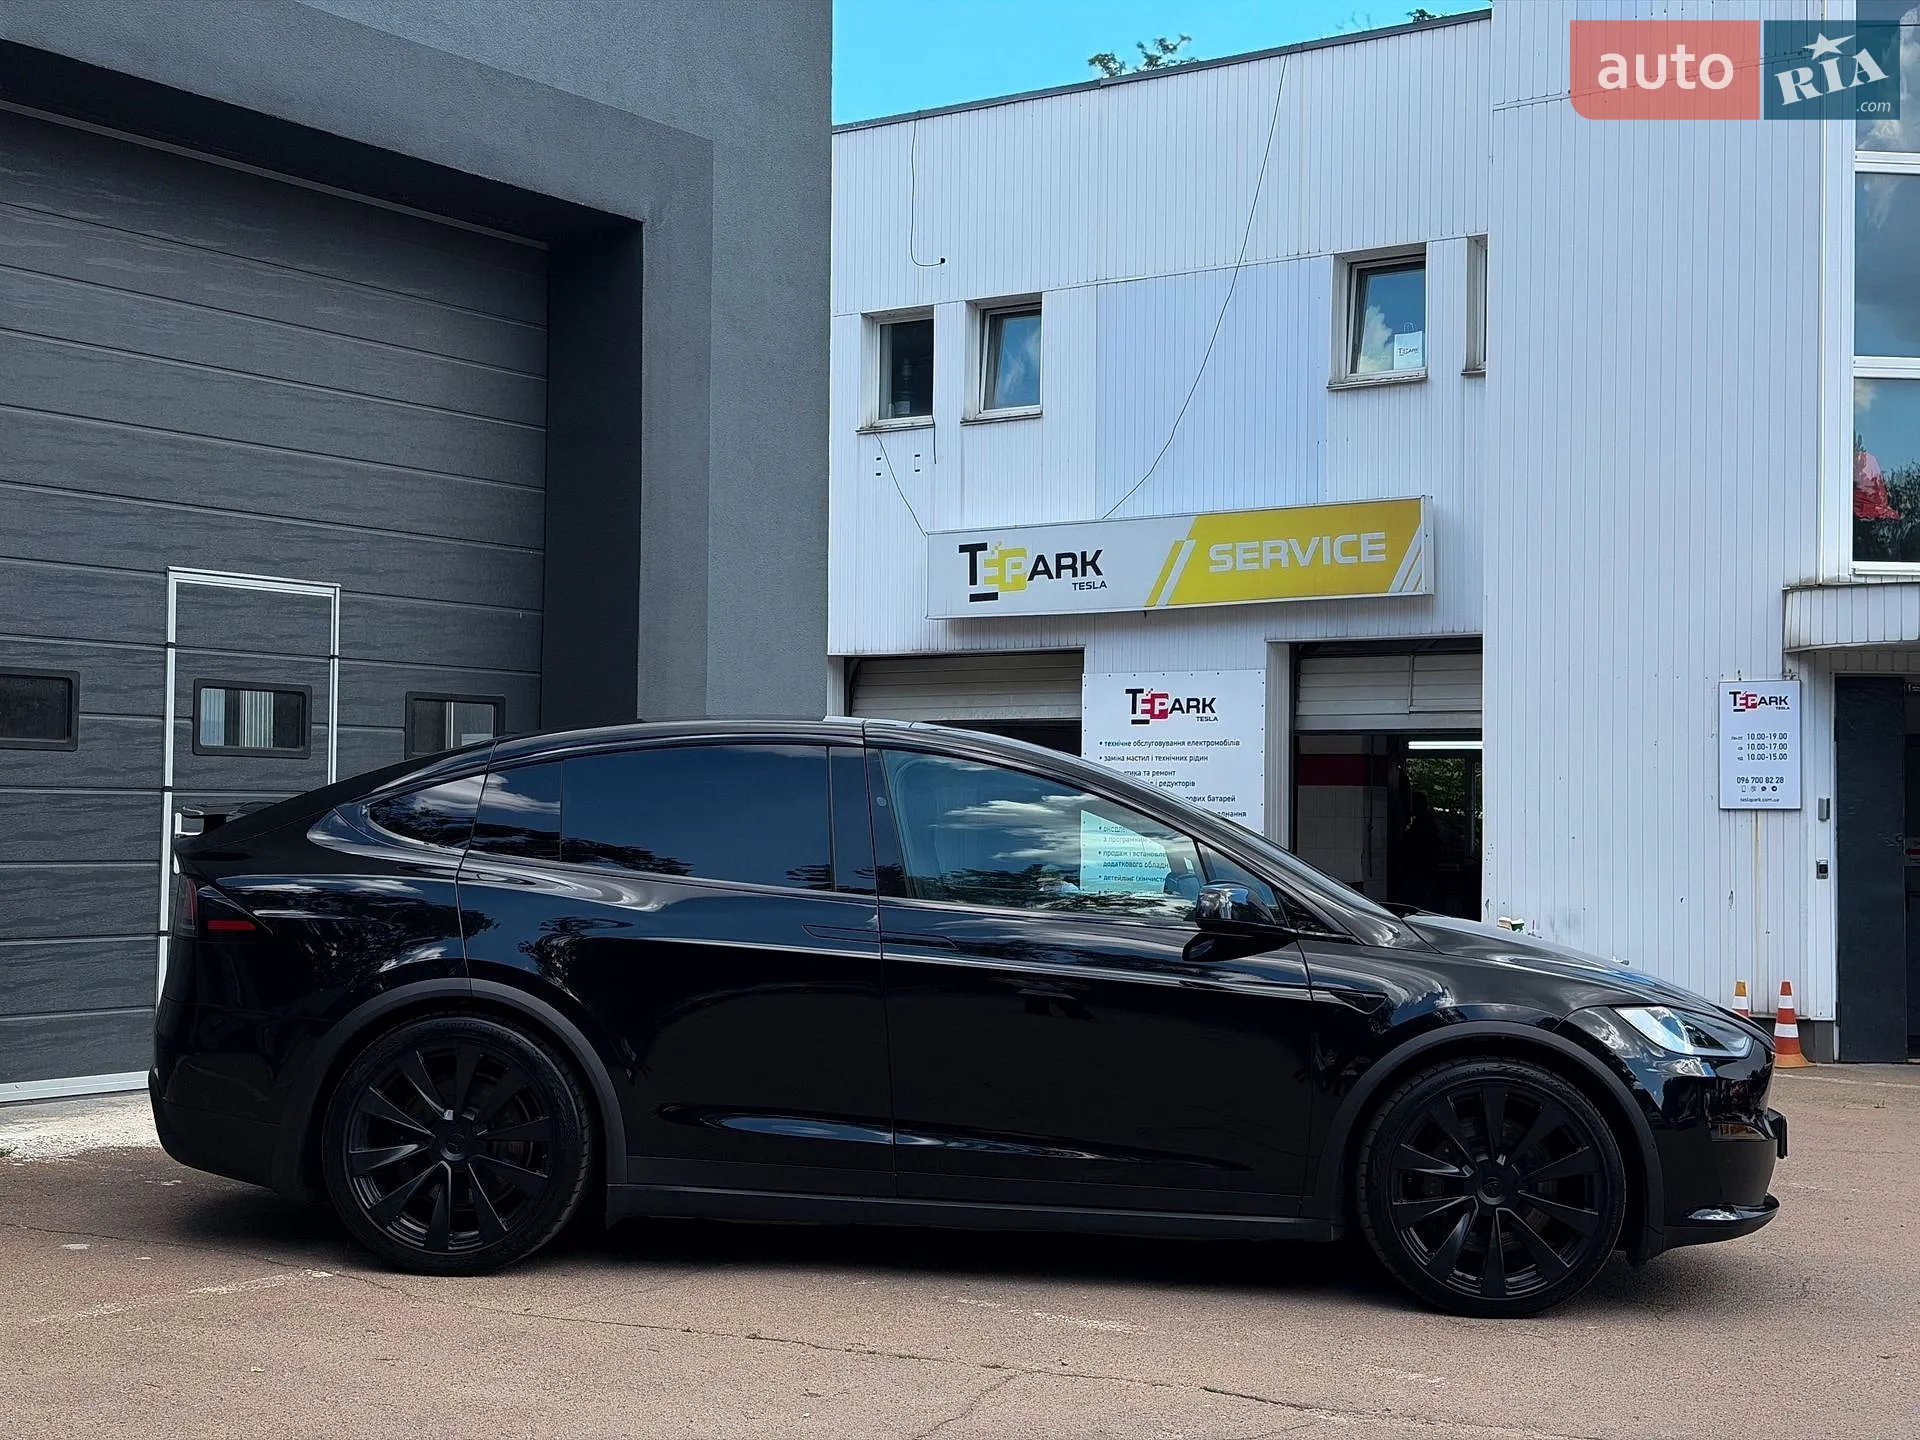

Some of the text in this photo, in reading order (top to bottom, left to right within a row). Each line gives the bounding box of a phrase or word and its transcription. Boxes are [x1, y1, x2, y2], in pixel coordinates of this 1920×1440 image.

[1208, 531, 1387, 574] SERVICE
[1071, 580, 1108, 591] TESLA
[1747, 732, 1788, 740] 10.00-19.00
[1132, 739, 1186, 748] обслуговування
[1187, 739, 1241, 748] електромобілів
[1747, 742, 1788, 750] 10.00-17.00
[1189, 754, 1209, 763] рідин
[1747, 752, 1788, 760] 10.00-15.00
[1151, 770, 1176, 778] ремонт
[1158, 780, 1196, 788] редукторів
[1736, 776, 1784, 784] 096 700 82 28
[1207, 794, 1236, 803] батарей
